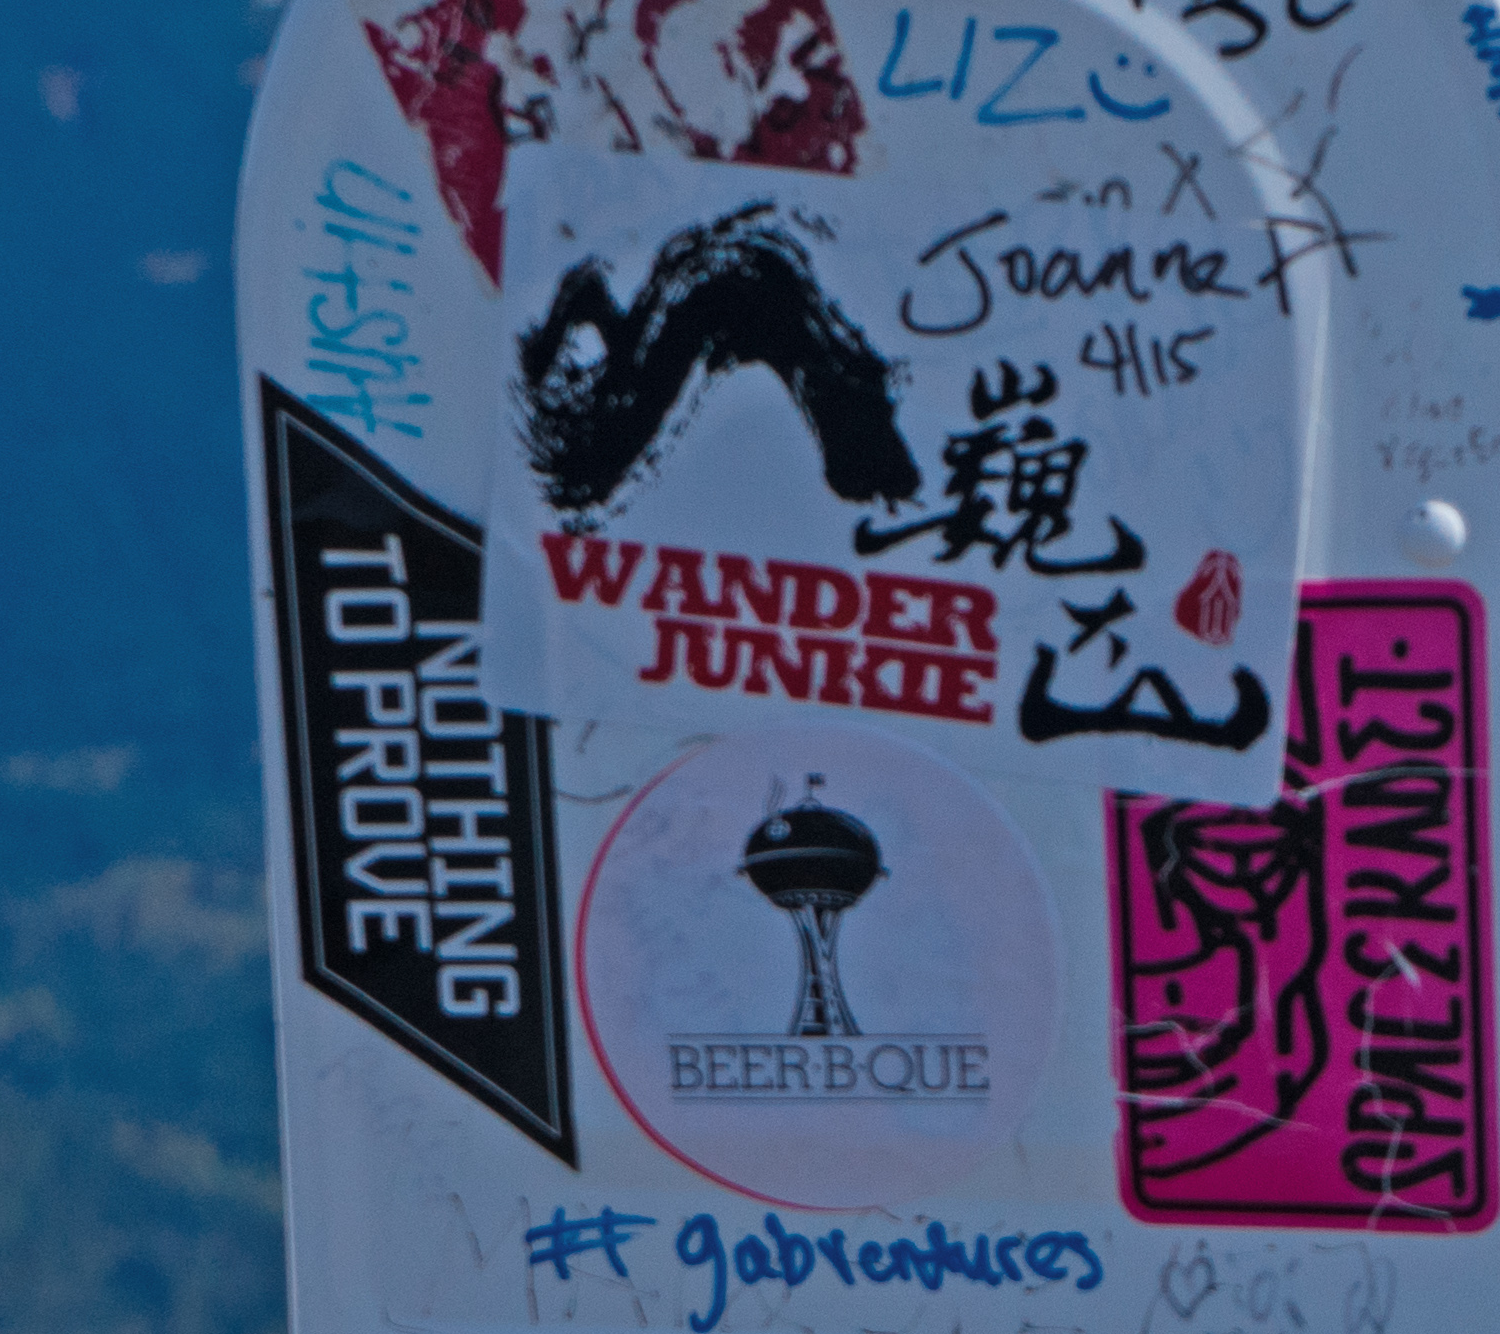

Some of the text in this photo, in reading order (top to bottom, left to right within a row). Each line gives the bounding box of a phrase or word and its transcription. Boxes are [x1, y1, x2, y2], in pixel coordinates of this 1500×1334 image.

[876, 7, 1087, 127] LIZ
[541, 532, 999, 652] WANDER
[638, 618, 997, 725] JUNKIE
[320, 533, 434, 956] TO PROVE
[414, 619, 522, 1019] NOTHING
